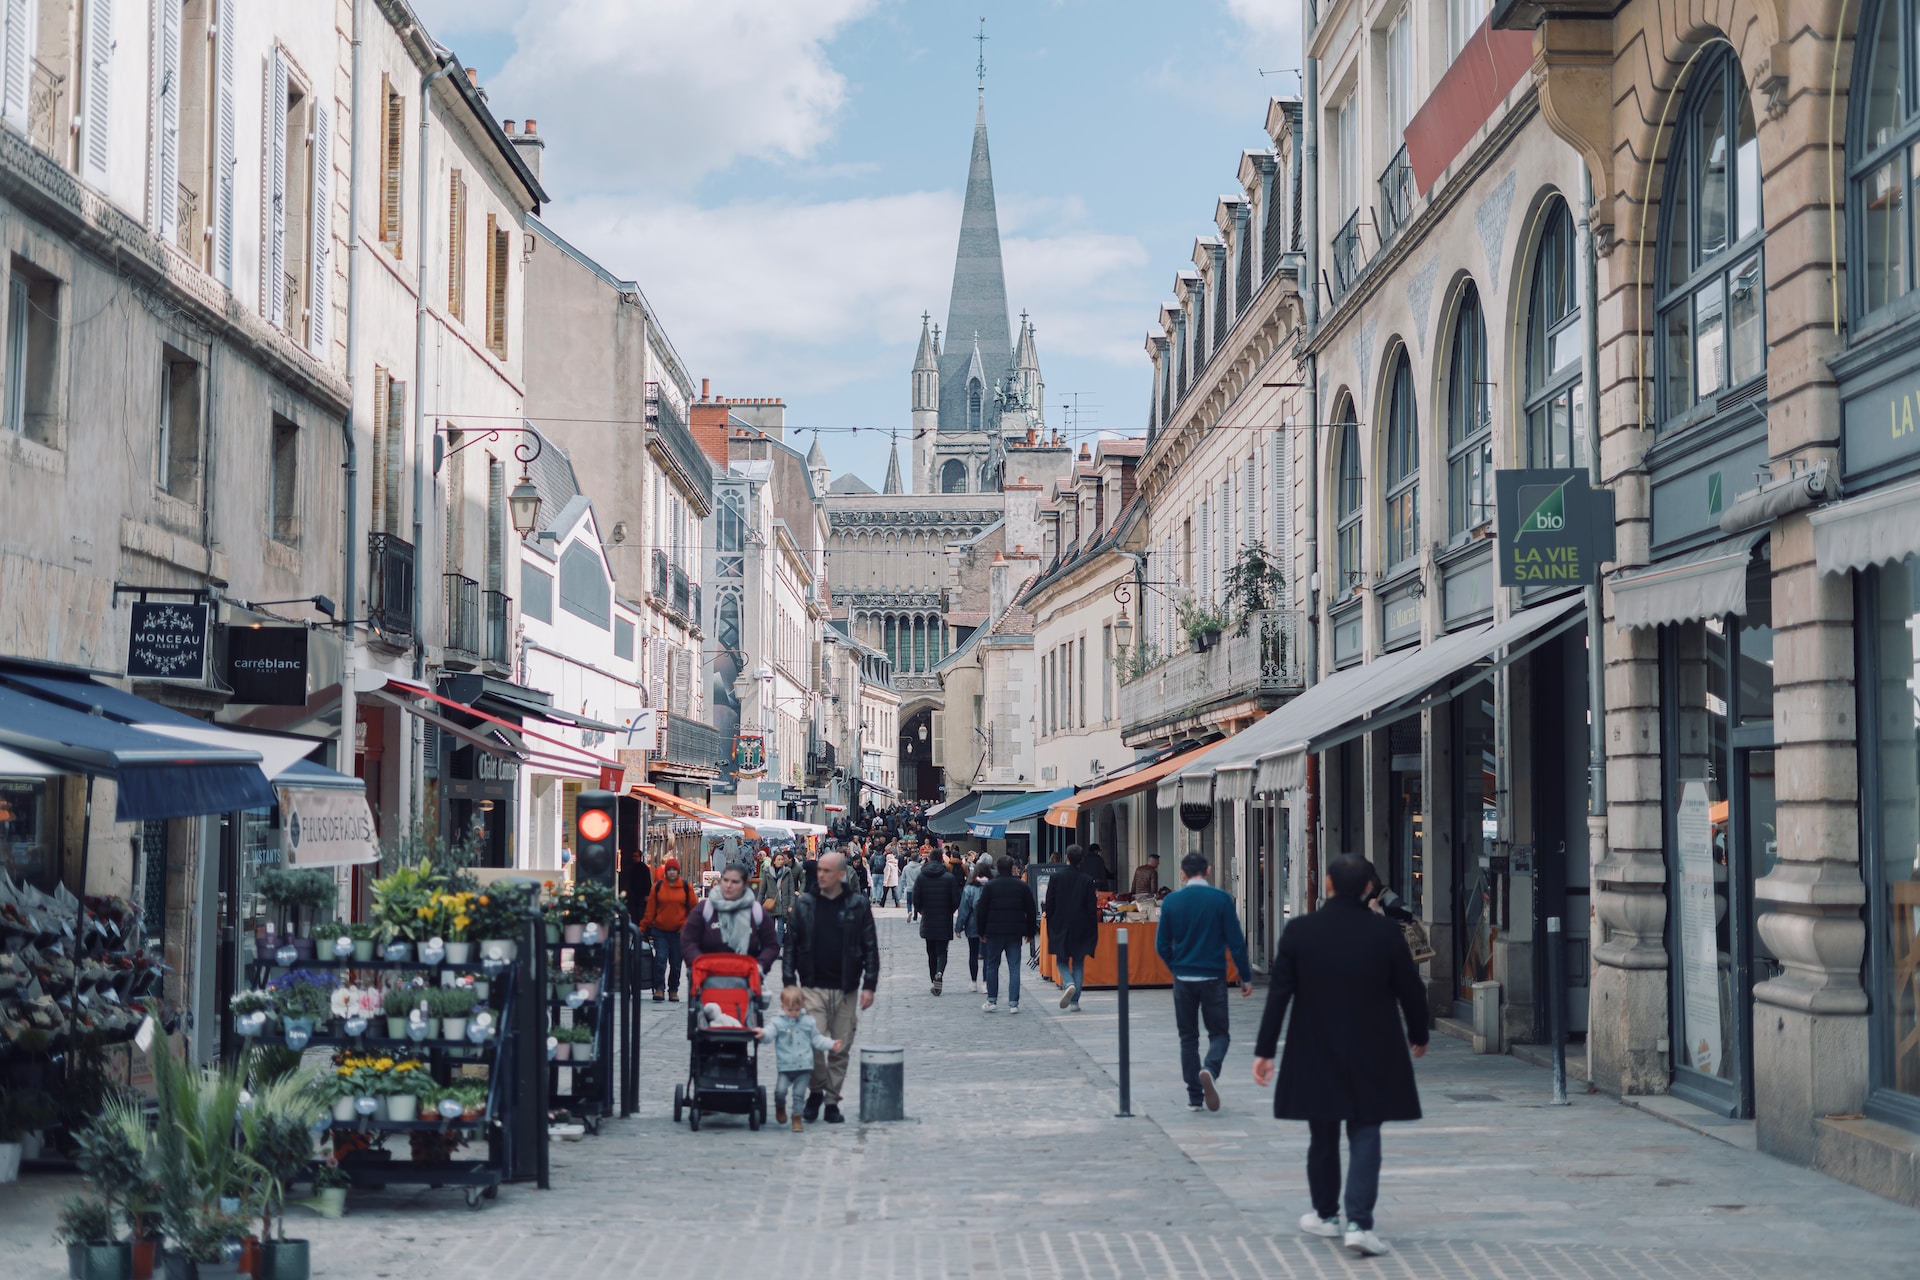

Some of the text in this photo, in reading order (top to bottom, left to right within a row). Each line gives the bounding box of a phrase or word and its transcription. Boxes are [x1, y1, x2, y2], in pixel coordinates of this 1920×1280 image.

[1890, 394, 1914, 439] LA
[1536, 511, 1563, 530] bio
[1514, 546, 1579, 563] LA VIE
[1514, 564, 1580, 580] SAINE
[134, 632, 201, 645] MONCEAU
[234, 657, 301, 669] carréblanc
[252, 847, 281, 865] INSTANTS
